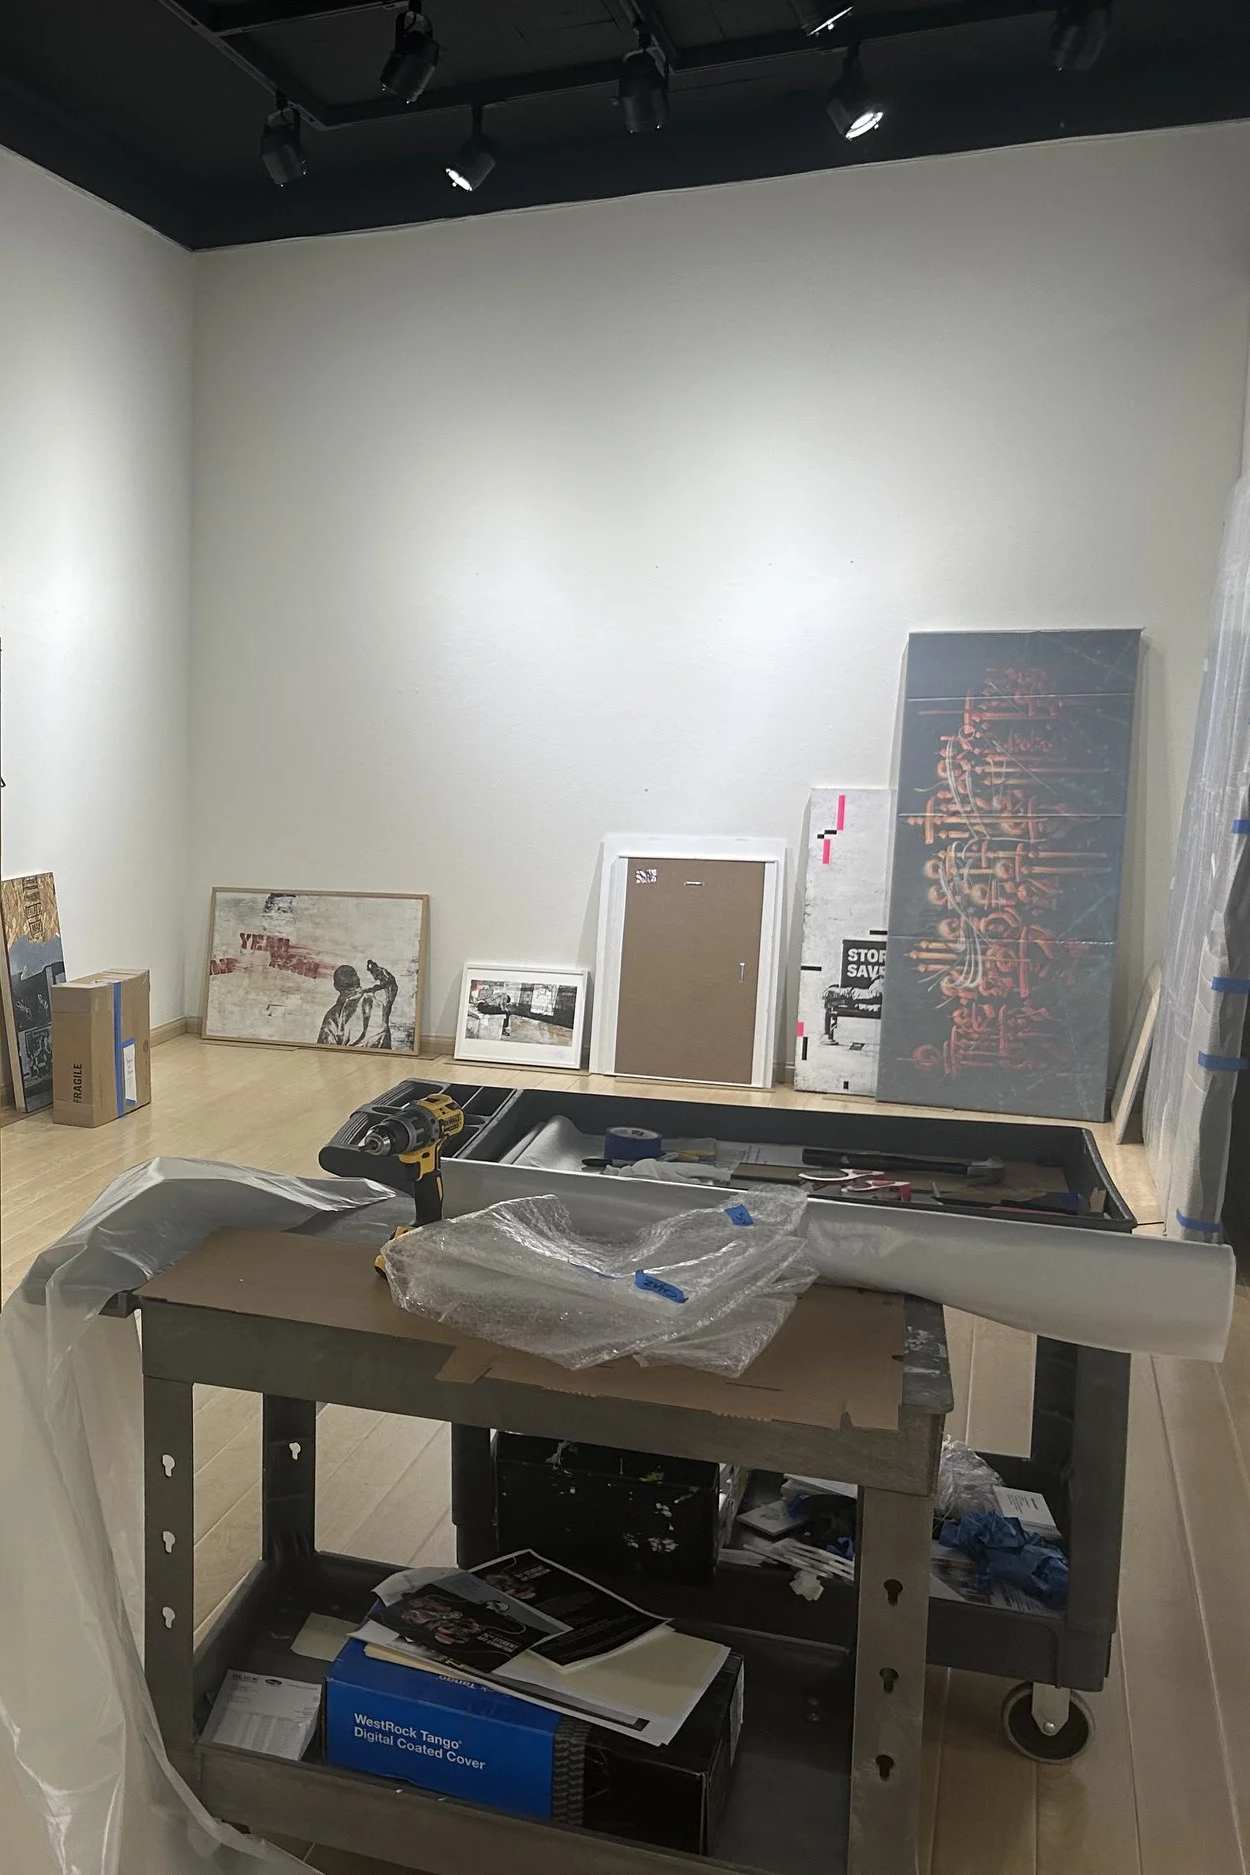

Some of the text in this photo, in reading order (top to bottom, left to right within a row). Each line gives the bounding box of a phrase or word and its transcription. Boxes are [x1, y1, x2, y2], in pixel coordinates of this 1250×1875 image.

[72, 1064, 82, 1104] FRAGILE
[354, 1713, 417, 1739] WestRock
[354, 1726, 486, 1770] Digital Coated Cover
